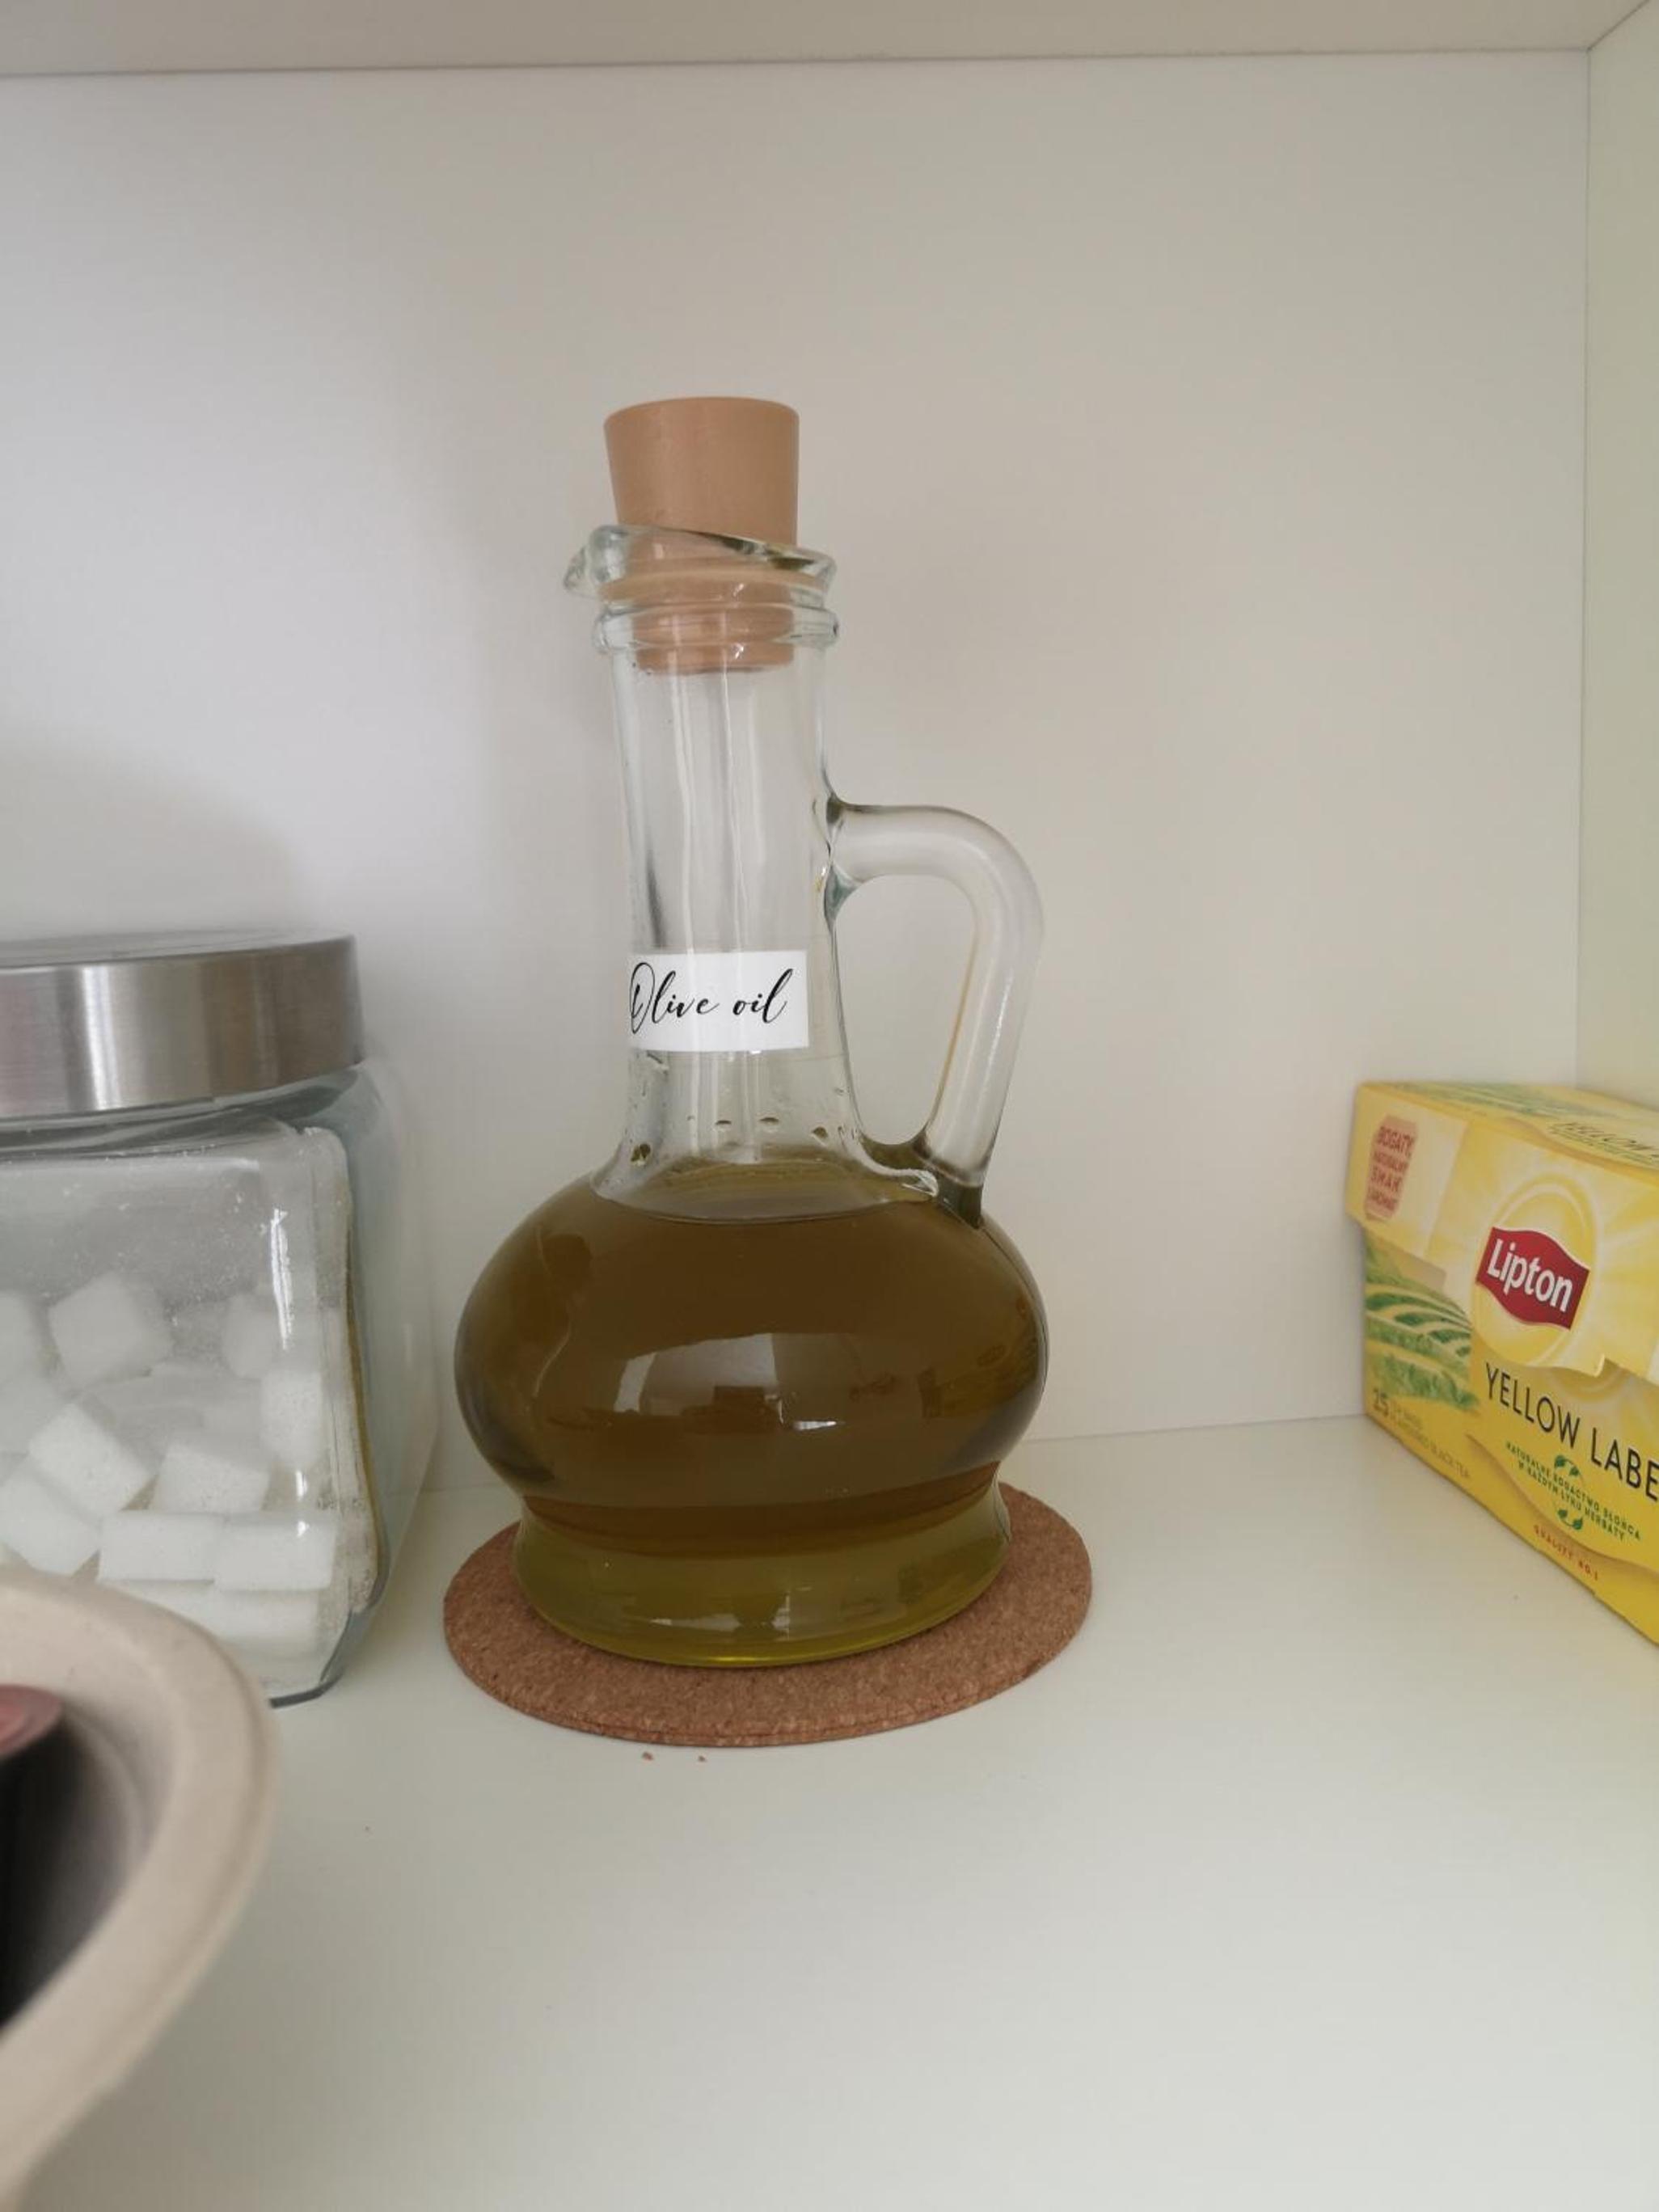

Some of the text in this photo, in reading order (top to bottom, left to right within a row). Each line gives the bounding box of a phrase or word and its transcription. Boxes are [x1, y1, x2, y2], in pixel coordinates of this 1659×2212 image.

[629, 962, 794, 1034] Olive oil
[1487, 1238, 1573, 1313] Lipton
[1484, 1361, 1581, 1449] YELLOW
[1553, 1473, 1600, 1511] BOGACTWO
